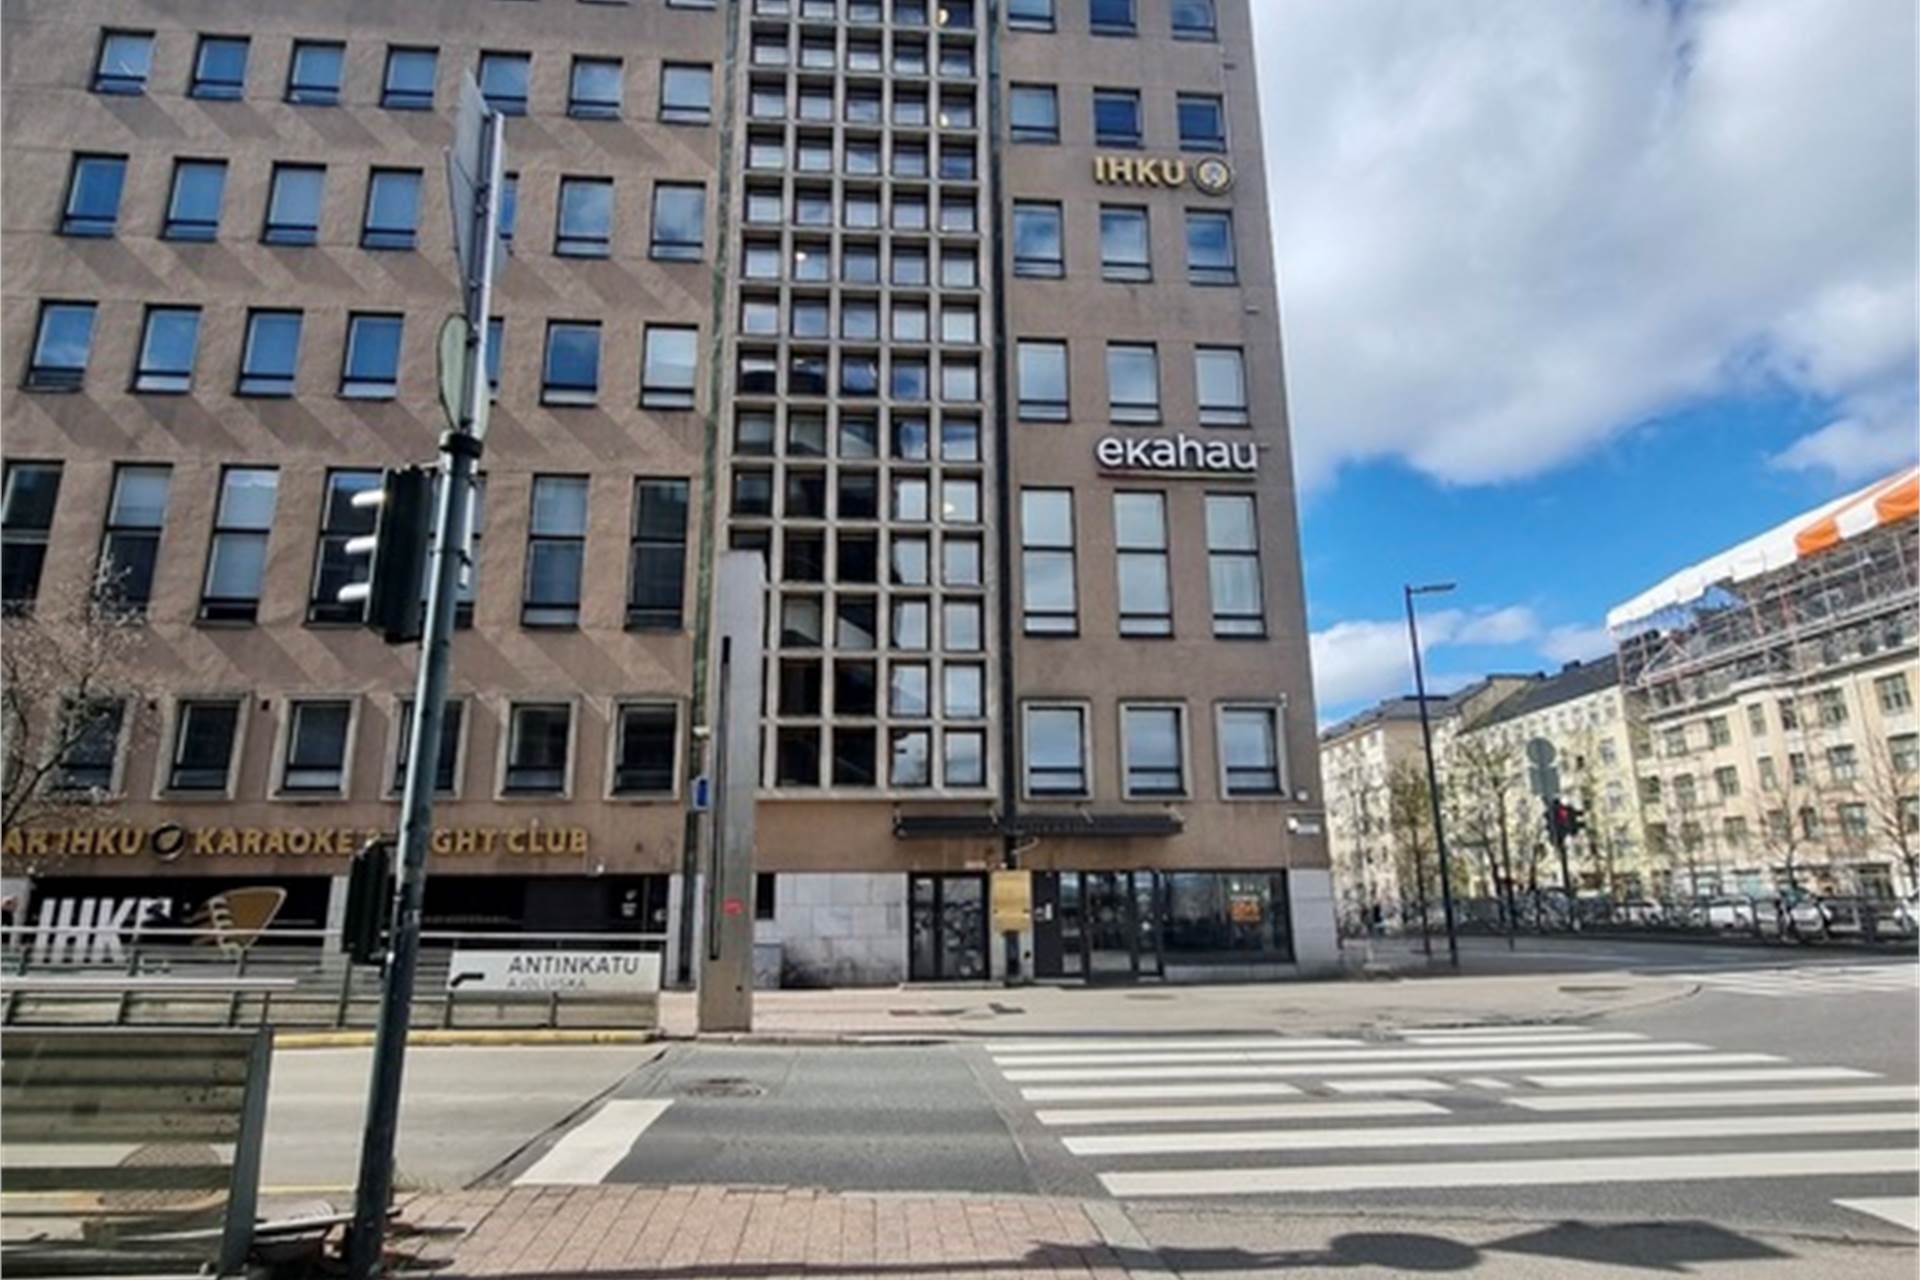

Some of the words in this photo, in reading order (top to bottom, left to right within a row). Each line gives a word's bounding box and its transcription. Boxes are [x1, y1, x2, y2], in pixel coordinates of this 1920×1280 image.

[1093, 155, 1186, 187] IHKU
[1096, 433, 1259, 471] ekahau
[2, 826, 49, 855] AR
[58, 826, 146, 855] IHKU
[194, 826, 355, 856] KARAOKE
[431, 826, 498, 855] GHT
[506, 826, 589, 856] CLUB
[507, 955, 641, 975] ANTINKATU
